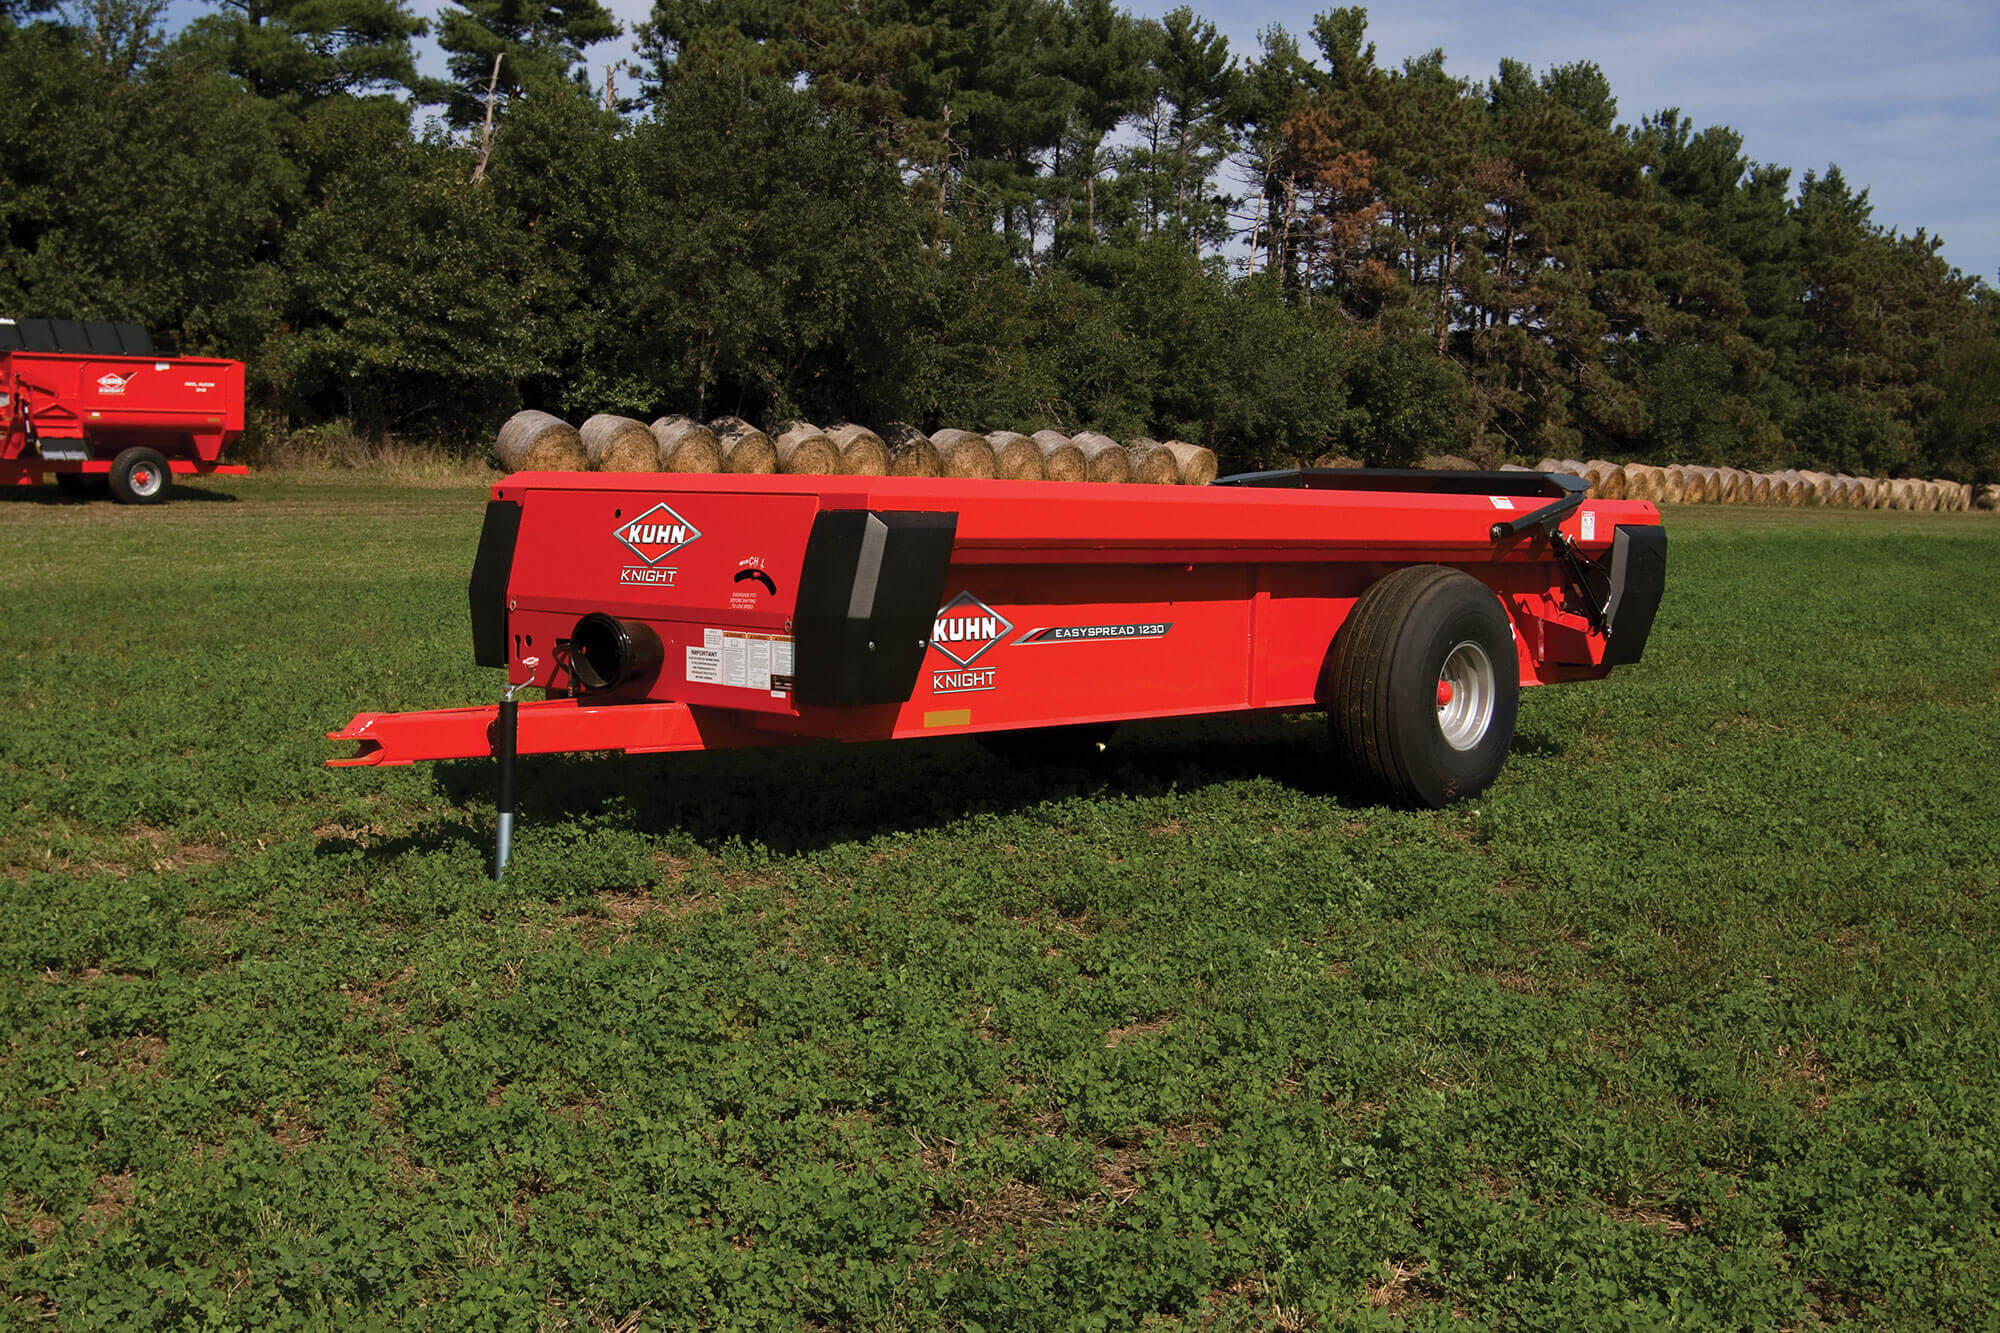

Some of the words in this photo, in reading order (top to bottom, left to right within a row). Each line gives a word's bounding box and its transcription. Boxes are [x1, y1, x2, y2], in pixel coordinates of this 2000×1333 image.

[628, 524, 687, 544] KUHN
[620, 569, 677, 583] KNIGHT
[933, 616, 997, 642] KUHN
[1055, 625, 1135, 638] EASYSPREAD
[1138, 624, 1165, 635] 1230
[690, 649, 718, 658] IMPORTANT
[933, 671, 996, 690] KNIGHT
